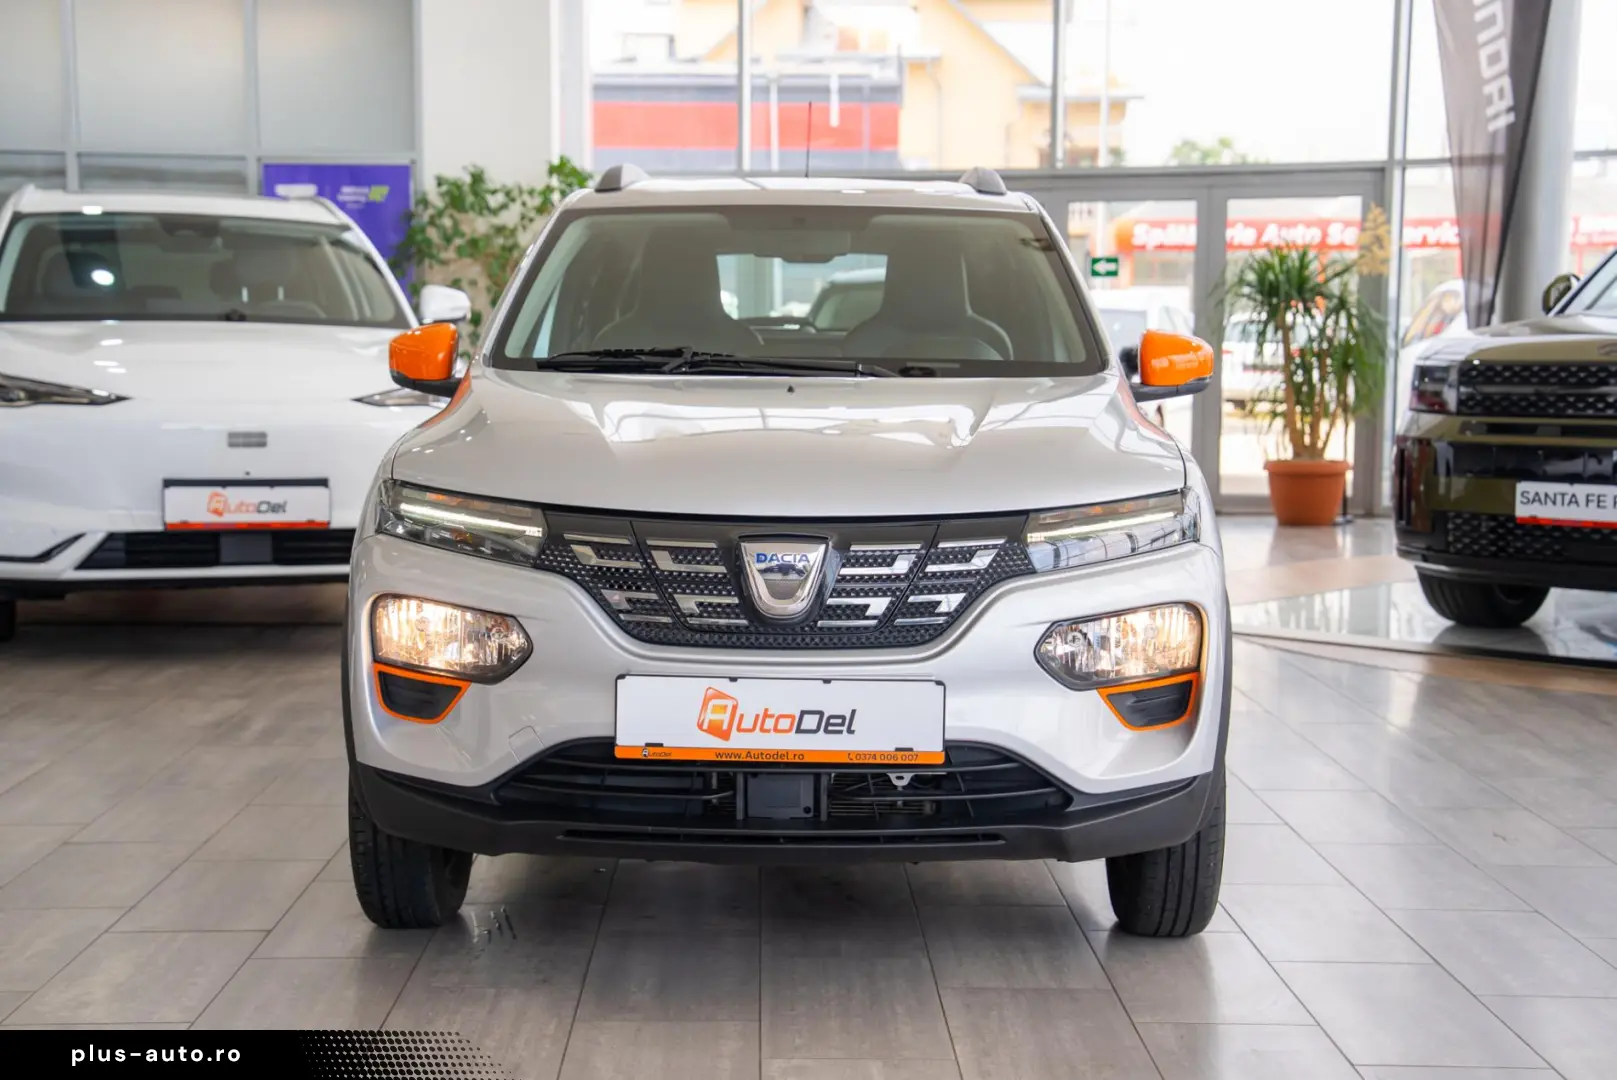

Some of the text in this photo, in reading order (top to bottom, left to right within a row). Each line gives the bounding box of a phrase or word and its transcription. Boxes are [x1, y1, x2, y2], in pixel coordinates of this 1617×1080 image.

[1473, 0, 1516, 133] NDAI
[1519, 489, 1580, 508] SANTA
[1585, 492, 1608, 510] FE
[755, 552, 810, 564] DACIA
[698, 690, 857, 740] AutoDel
[715, 750, 805, 762] www.Autodel.ro
[854, 752, 919, 763] 0374 006 007
